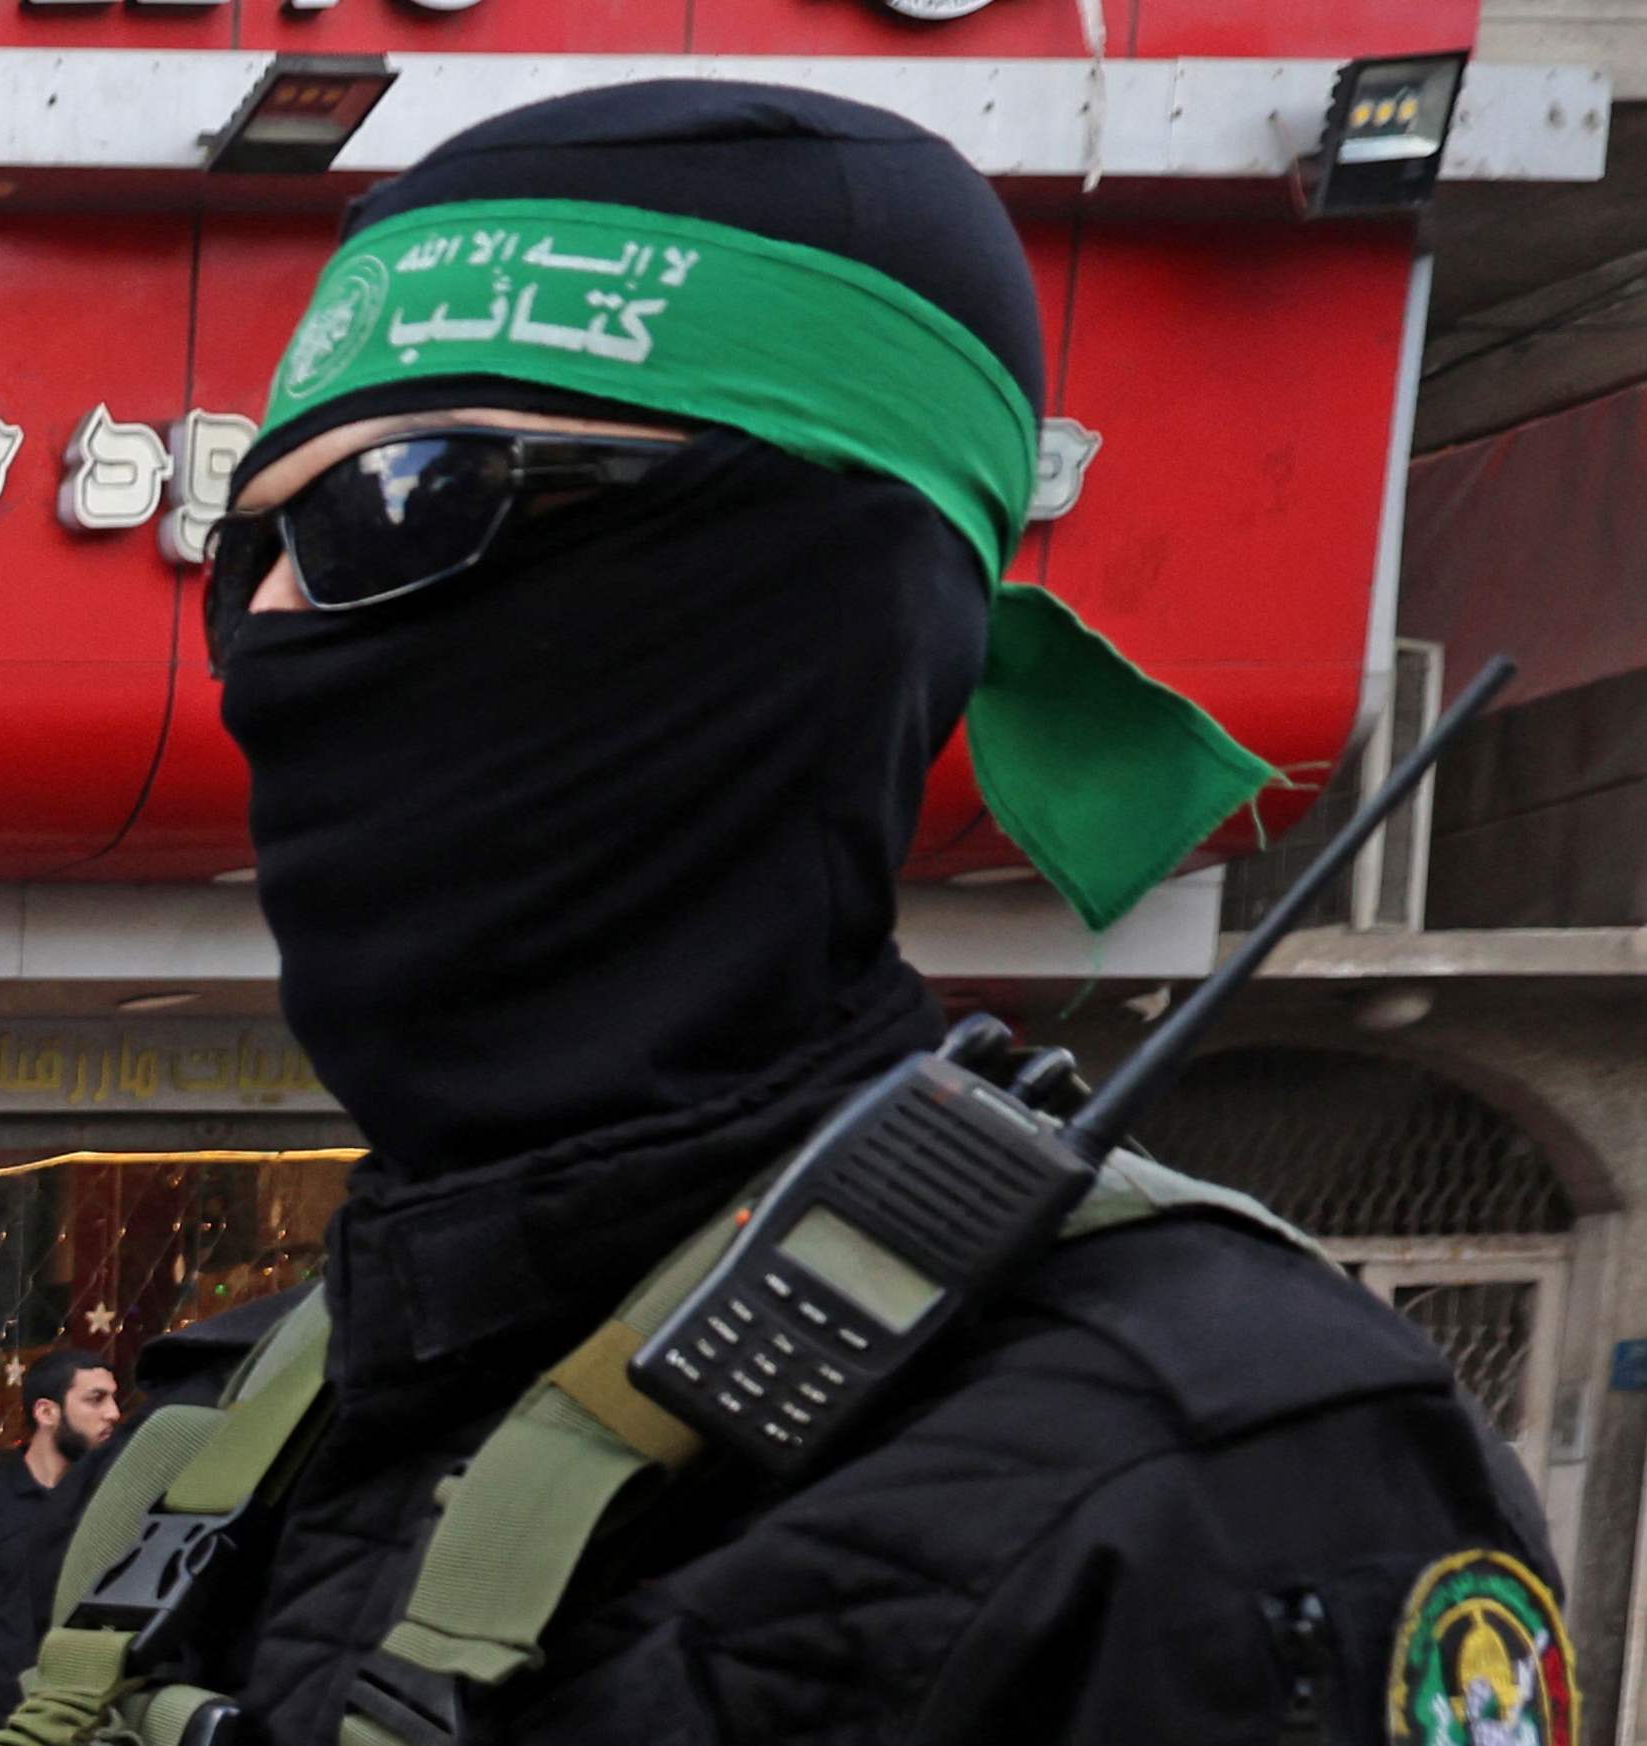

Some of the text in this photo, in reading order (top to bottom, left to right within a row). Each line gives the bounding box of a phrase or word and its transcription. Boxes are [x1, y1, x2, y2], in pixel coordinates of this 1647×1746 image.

[395, 233, 463, 273] الله
[658, 244, 701, 287] لا
[388, 272, 668, 364] كتائب
